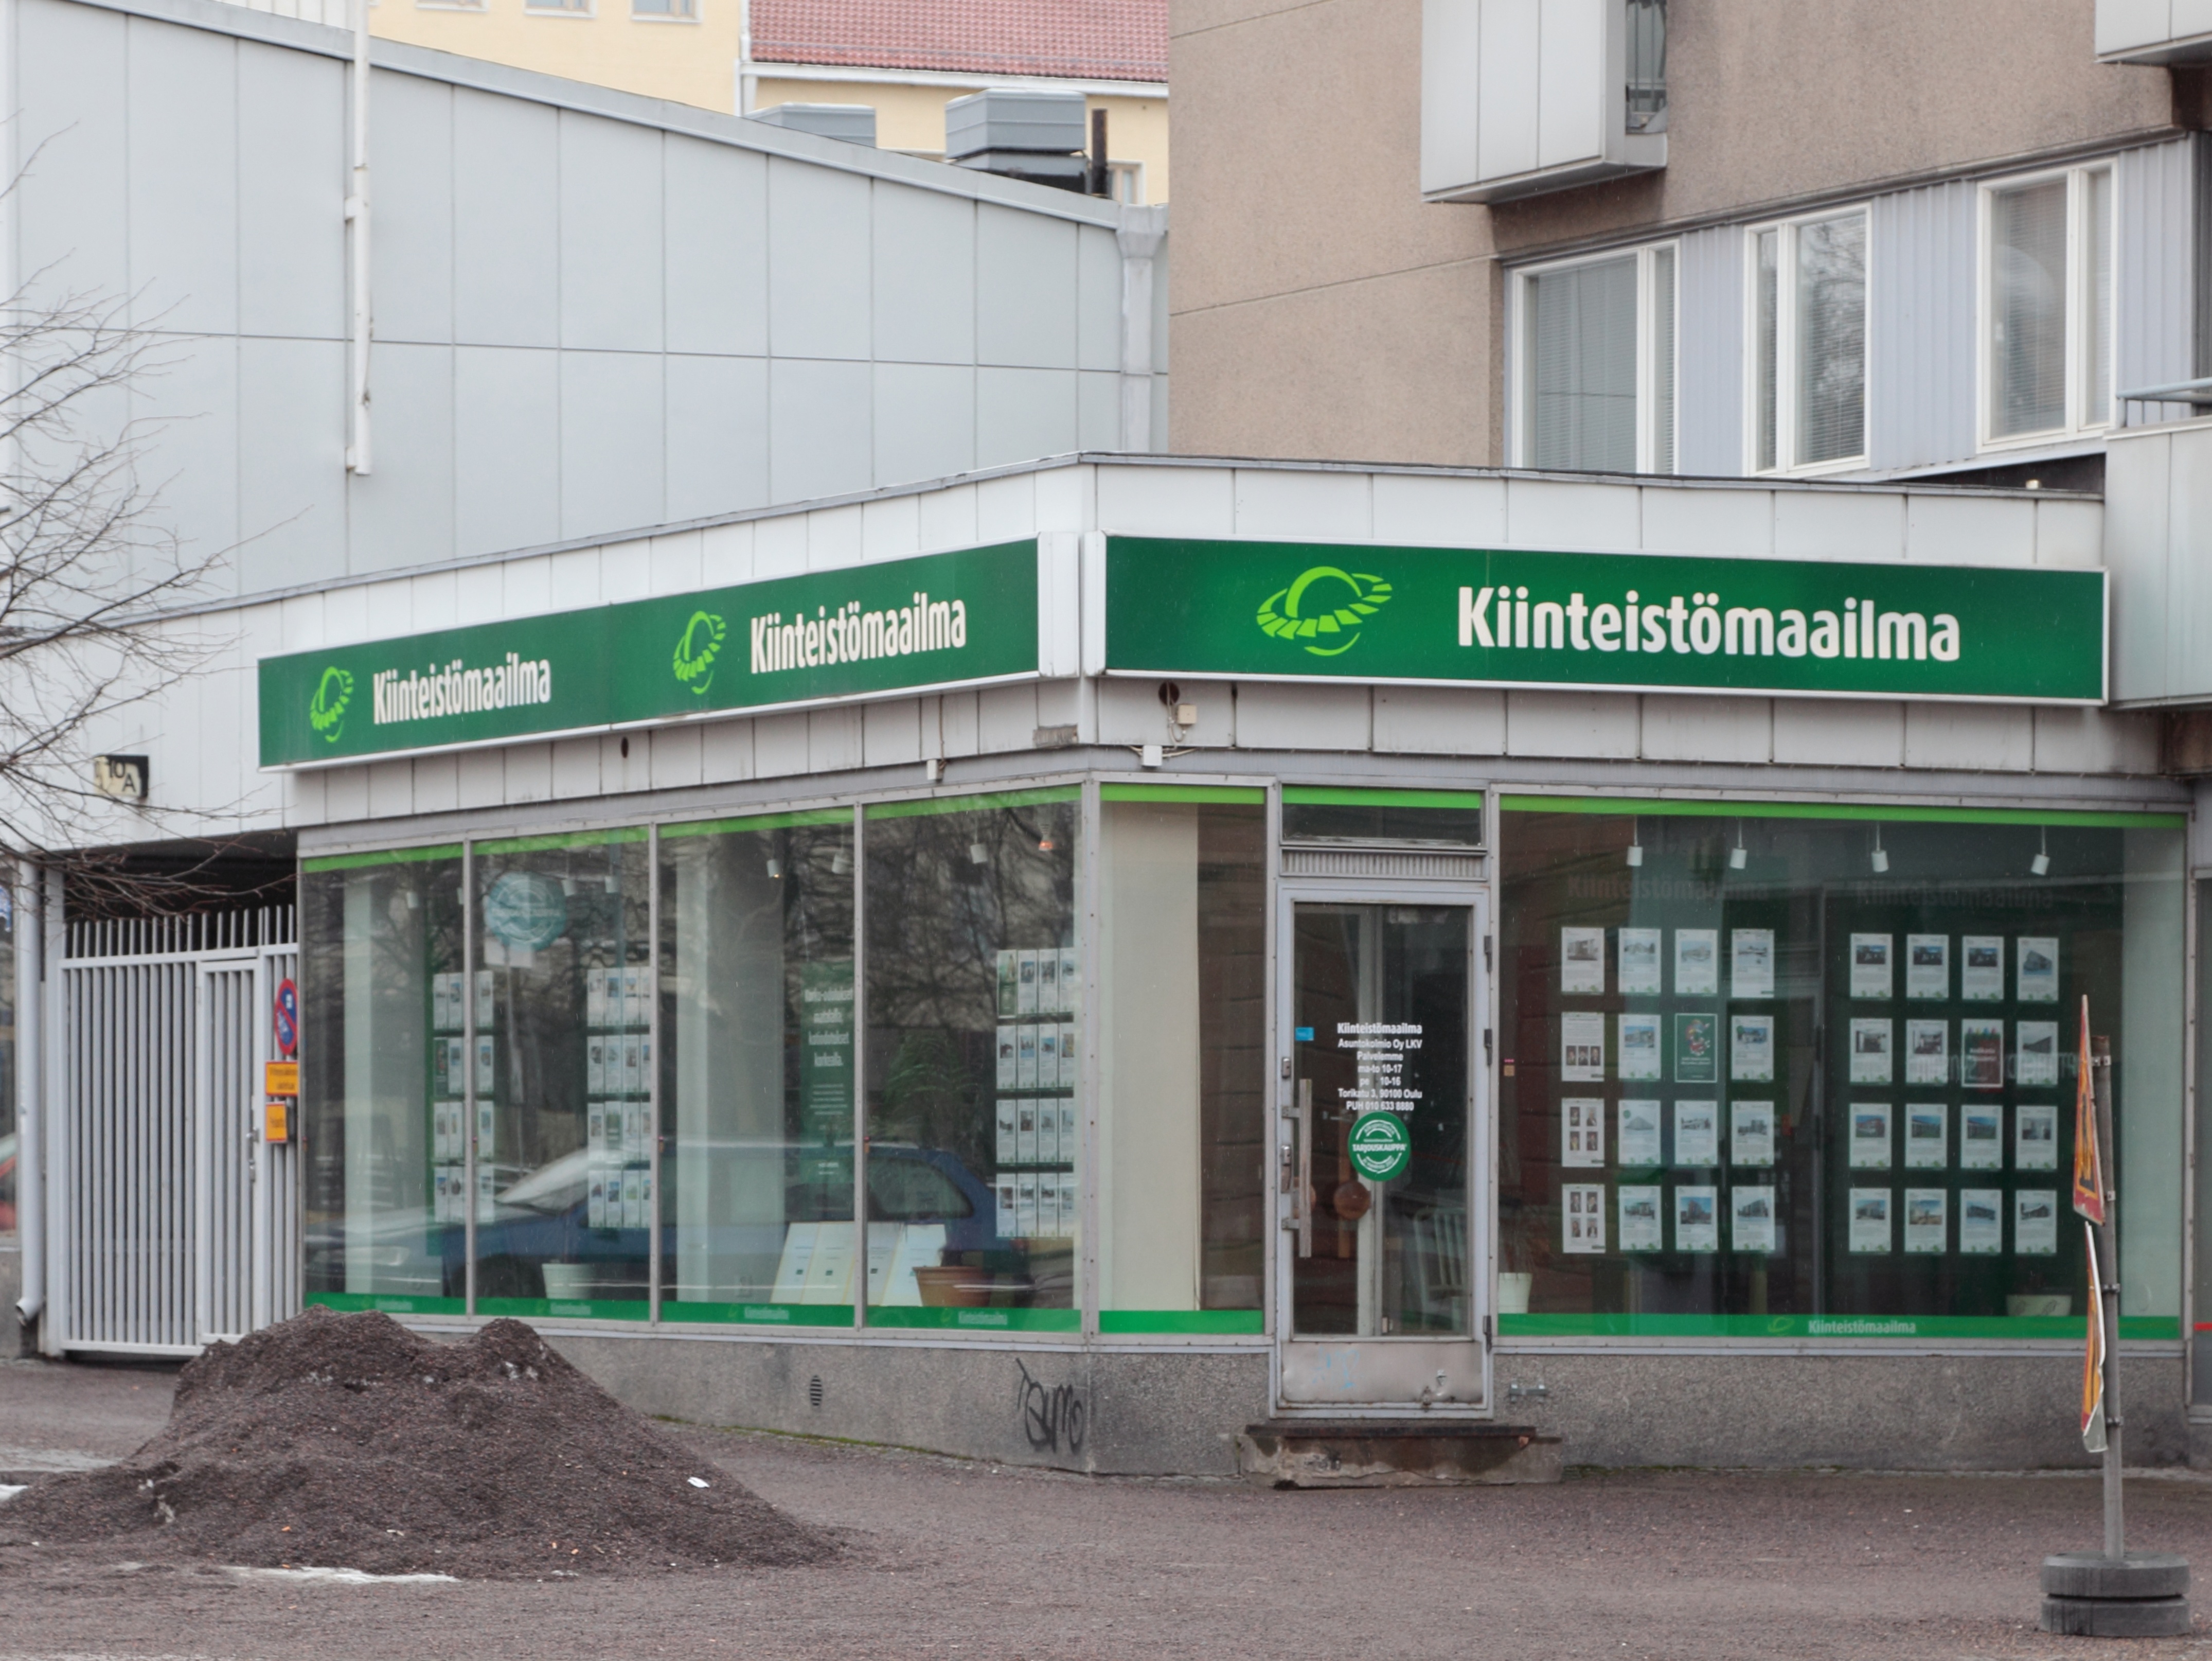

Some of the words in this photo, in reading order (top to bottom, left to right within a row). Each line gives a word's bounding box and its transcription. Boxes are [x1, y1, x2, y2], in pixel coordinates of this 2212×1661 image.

[1458, 586, 1961, 662] Kiinteistömaailma
[750, 592, 967, 675] Kiinteistömaailma
[373, 651, 552, 726] Kiinteistömaailma
[121, 773, 136, 792] A
[1337, 1022, 1422, 1034] Kiinteistömaailma
[1393, 1039, 1404, 1051] Oy
[1405, 1039, 1422, 1049] LKV
[1357, 1052, 1403, 1061] Palvelemme
[1382, 1065, 1402, 1073] 10-17
[1360, 1079, 1370, 1087] pe
[1380, 1077, 1401, 1085] 10-16
[1337, 1089, 1369, 1097] Torikatu
[1371, 1090, 1378, 1099] 3,
[1380, 1089, 1402, 1098] 90100
[1403, 1089, 1422, 1098] Oulu
[1346, 1102, 1364, 1110] PUH
[1365, 1102, 1379, 1110] 010
[1380, 1102, 1394, 1110] 633
[1808, 1320, 1916, 1333] Kiinteistömaailma
